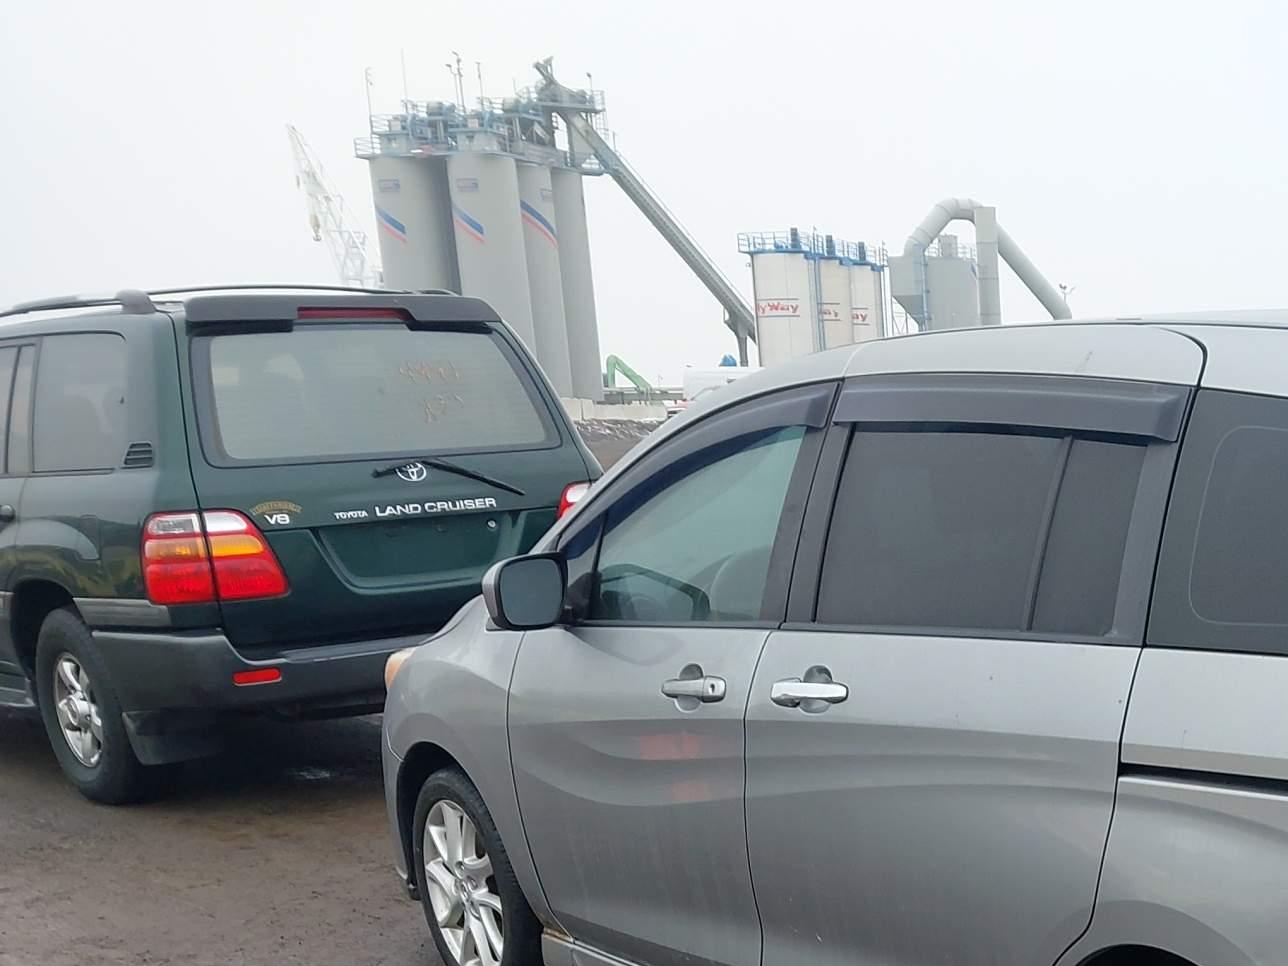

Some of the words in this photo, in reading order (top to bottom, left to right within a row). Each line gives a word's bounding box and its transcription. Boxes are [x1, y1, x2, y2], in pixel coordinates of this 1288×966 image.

[334, 510, 368, 520] TOYOTA
[375, 503, 421, 516] LAND
[424, 497, 497, 513] CRUISER
[263, 513, 290, 525] V8
